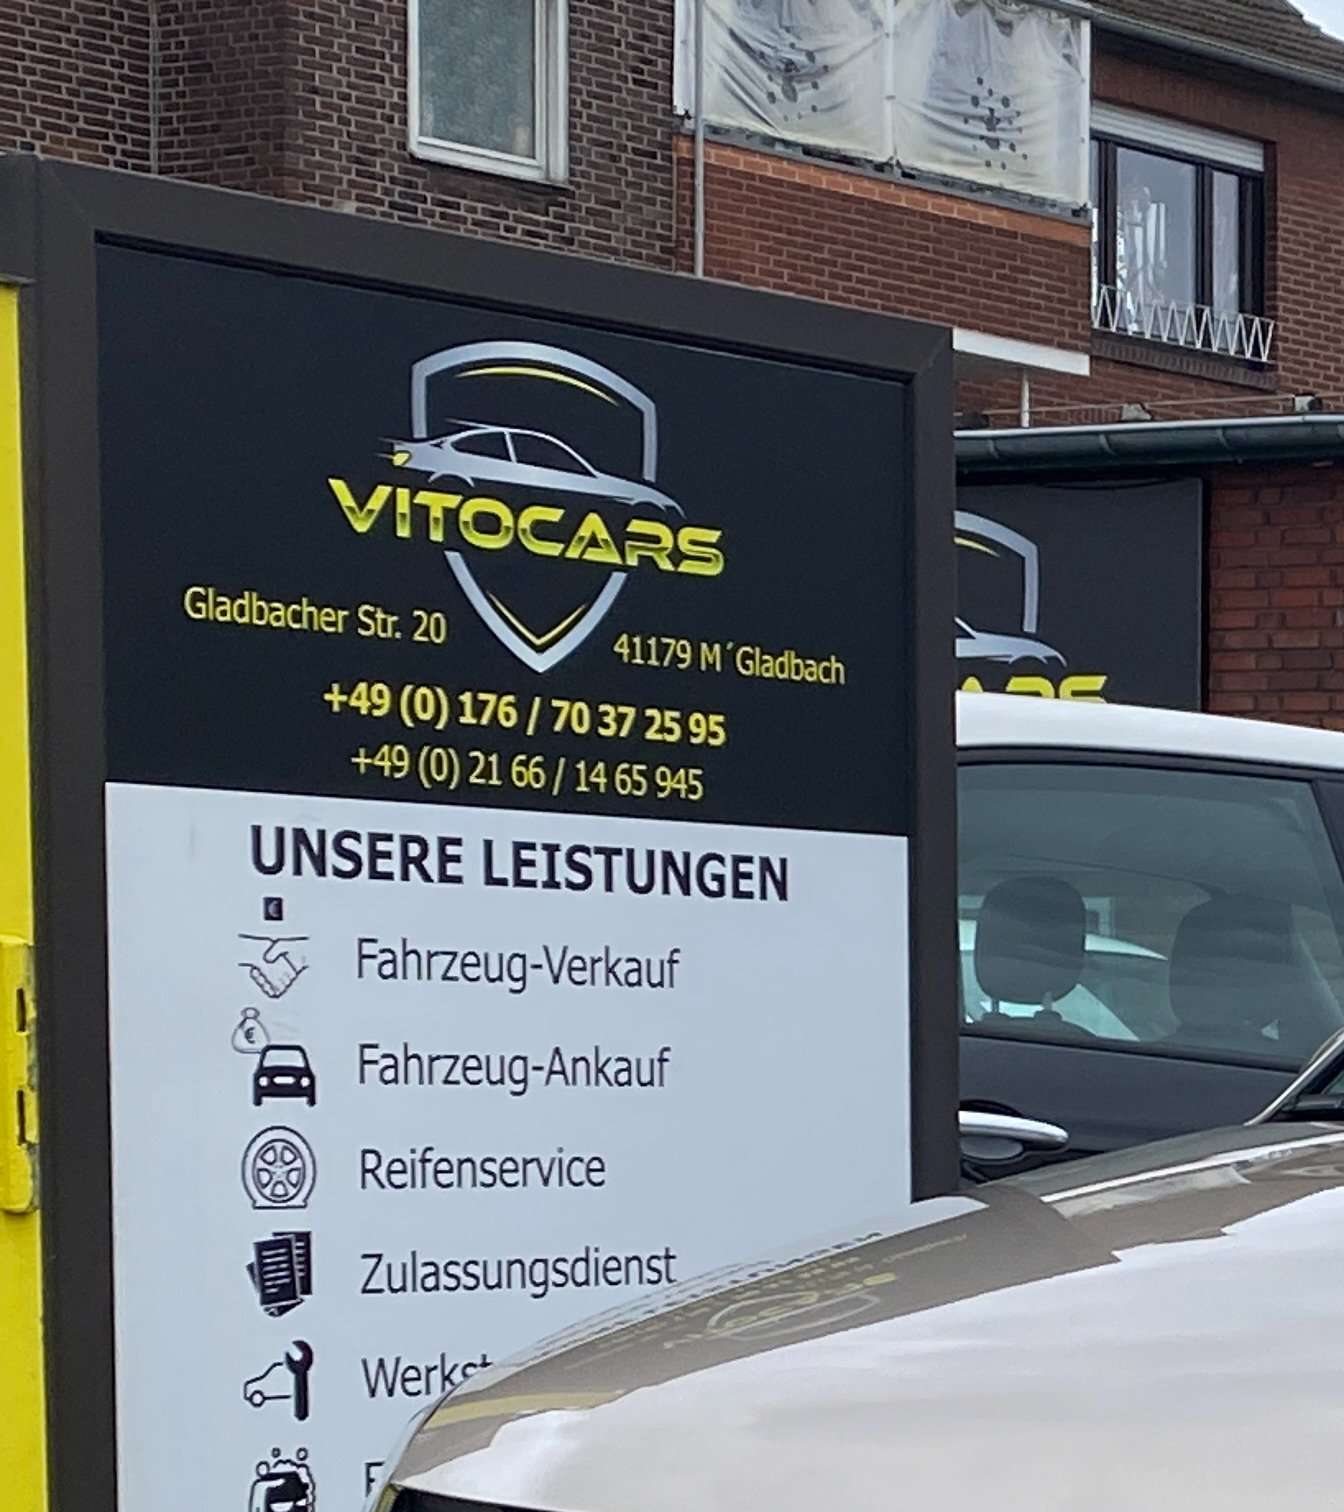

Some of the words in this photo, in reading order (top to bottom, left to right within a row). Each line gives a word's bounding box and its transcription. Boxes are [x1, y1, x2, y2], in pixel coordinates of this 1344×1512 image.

[328, 477, 725, 577] VITOCARS
[184, 586, 350, 634] Gladbacher
[357, 604, 402, 639] Str.
[412, 610, 447, 644] 20
[613, 633, 692, 671] 41179
[323, 682, 392, 717] +49
[400, 684, 449, 730] (0)
[458, 691, 519, 729] 176
[526, 696, 542, 736] /
[551, 699, 591, 735] 70
[597, 703, 637, 738] 37
[644, 707, 682, 743] 25
[688, 712, 727, 747] 95
[351, 744, 410, 779] +49
[418, 745, 460, 790] (0)
[468, 750, 503, 785] 21
[511, 753, 547, 789] 66
[552, 757, 566, 796] /
[575, 759, 608, 794] 14
[614, 762, 649, 797] 65
[655, 765, 704, 801] 945
[250, 824, 465, 885] UNSERE
[482, 838, 789, 902] LEISTUNGEN
[355, 936, 680, 994] Fahrzeug-Verkauf
[357, 1042, 671, 1096] Fahrzeug-Ankauf
[360, 1147, 607, 1191] Reifenservice
[360, 1245, 678, 1299] Zulassungsdienst
